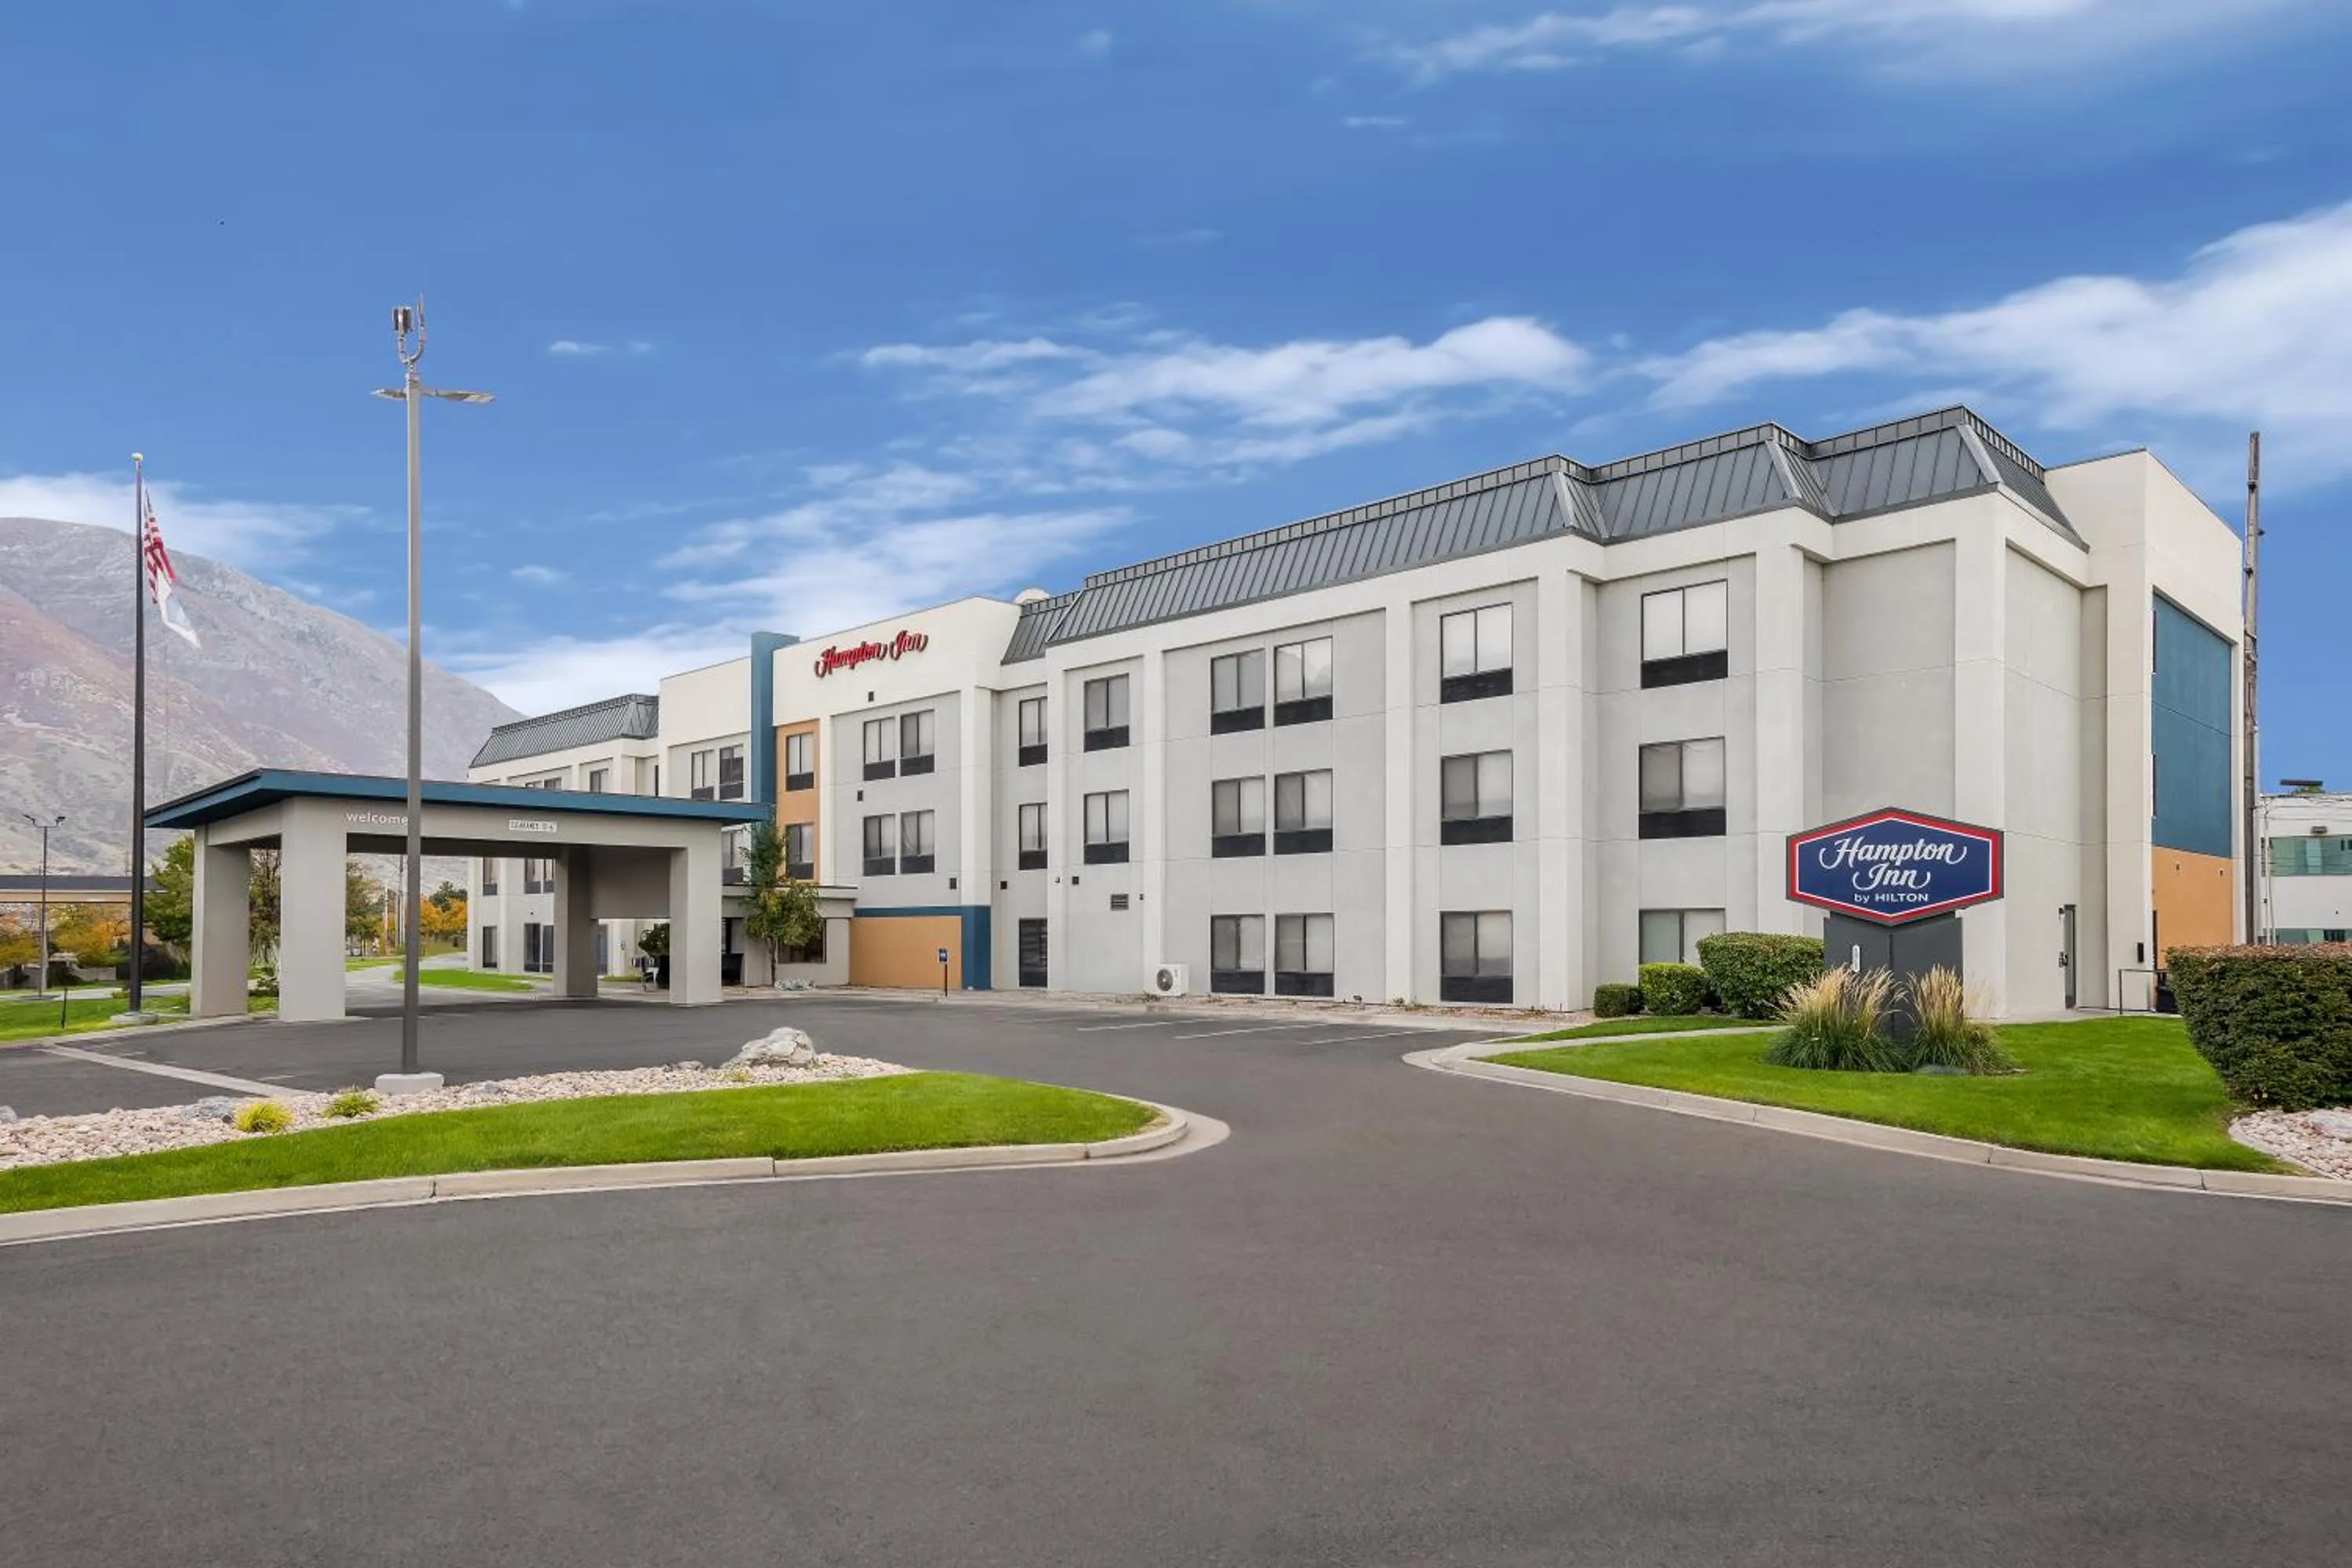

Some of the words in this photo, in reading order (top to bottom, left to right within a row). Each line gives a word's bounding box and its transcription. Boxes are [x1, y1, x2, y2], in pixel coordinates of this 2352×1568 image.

[814, 641, 888, 678] Hampton
[889, 629, 929, 661] Inn
[346, 811, 408, 826] welcome
[1818, 835, 1967, 869] Hampton
[1853, 862, 1931, 891] Inn
[1854, 893, 1870, 904] by
[1875, 893, 1929, 902] HILTON
